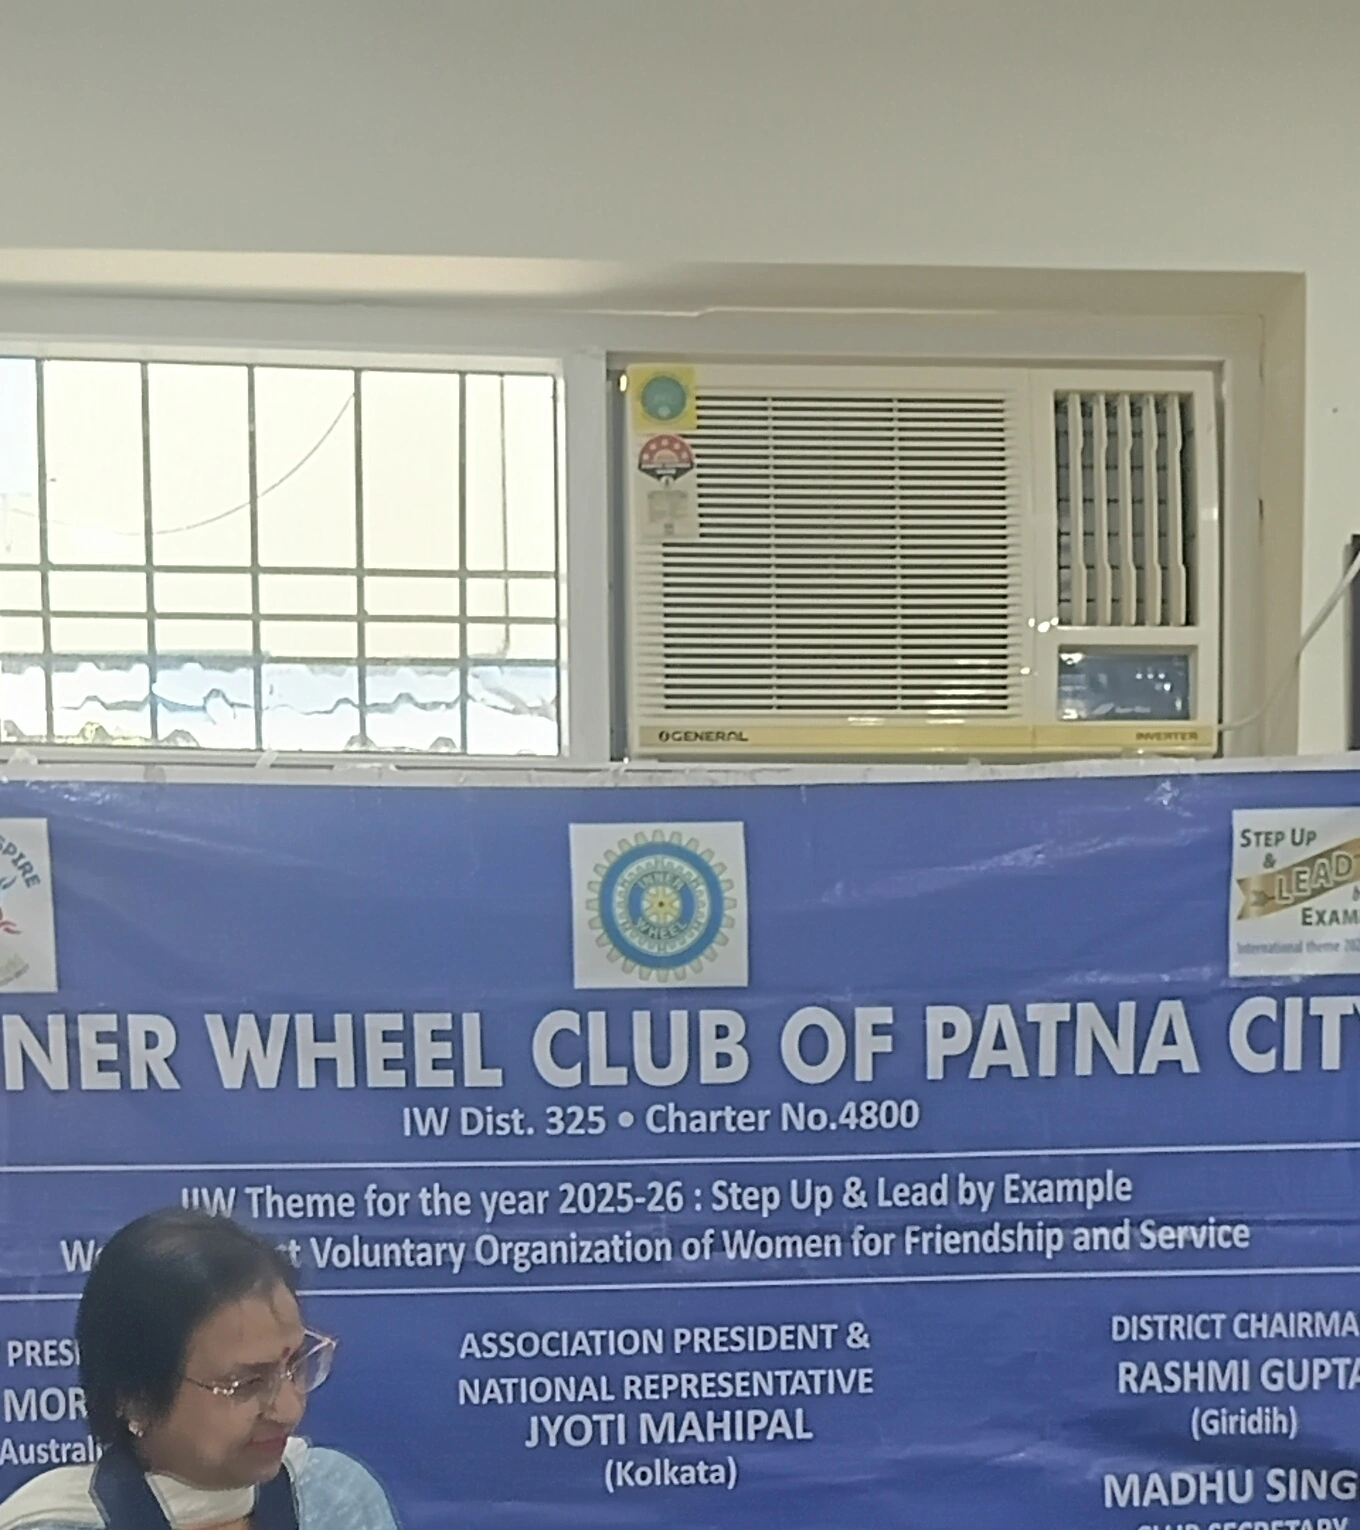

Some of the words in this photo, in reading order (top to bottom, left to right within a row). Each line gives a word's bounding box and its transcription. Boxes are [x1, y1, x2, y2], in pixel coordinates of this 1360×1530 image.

[1263, 852, 1277, 869] &
[1274, 851, 1354, 905] LEAD
[204, 1012, 503, 1090] WHEEL
[532, 1007, 749, 1088] CLUB
[780, 1005, 895, 1084] OF
[925, 1000, 1200, 1081] PATNA
[402, 1107, 448, 1137] IW
[460, 1106, 536, 1137] Dist.
[545, 1105, 607, 1136] 325
[645, 1101, 772, 1134] Charter
[781, 1098, 920, 1132] No.4800
[181, 1186, 237, 1218] IIW
[244, 1185, 356, 1219] Theme
[364, 1184, 412, 1218] for
[418, 1183, 471, 1217] the
[480, 1187, 549, 1226] year
[558, 1180, 685, 1215] 2025-26
[711, 1178, 781, 1219] Step
[790, 1178, 834, 1218] Up
[842, 1176, 869, 1210] &
[877, 1172, 949, 1208] Lead
[957, 1172, 996, 1213] by
[1004, 1168, 1133, 1211] Example
[310, 1233, 465, 1274] Voluntary
[474, 1230, 673, 1274] Organization
[682, 1230, 715, 1261] of
[722, 1228, 842, 1259] Women
[851, 1225, 896, 1258] for
[904, 1220, 1065, 1259] Friendship
[1072, 1218, 1132, 1254] and
[1139, 1216, 1251, 1250] Service
[459, 1328, 663, 1360] ASSOCIATION
[674, 1323, 839, 1355] PRESIDENT
[846, 1321, 871, 1350] &
[1111, 1312, 1227, 1342] DISTRICT
[458, 1374, 615, 1405] NATIONAL
[624, 1367, 875, 1402] REPRESENTATIVE
[1117, 1359, 1250, 1395] RASHMI
[525, 1413, 626, 1449] JYOTI
[639, 1406, 815, 1445] MAHIPAL
[1190, 1404, 1299, 1441] (Giridih)
[604, 1454, 738, 1495] (Kolkata)
[1103, 1472, 1254, 1509] MADHU
